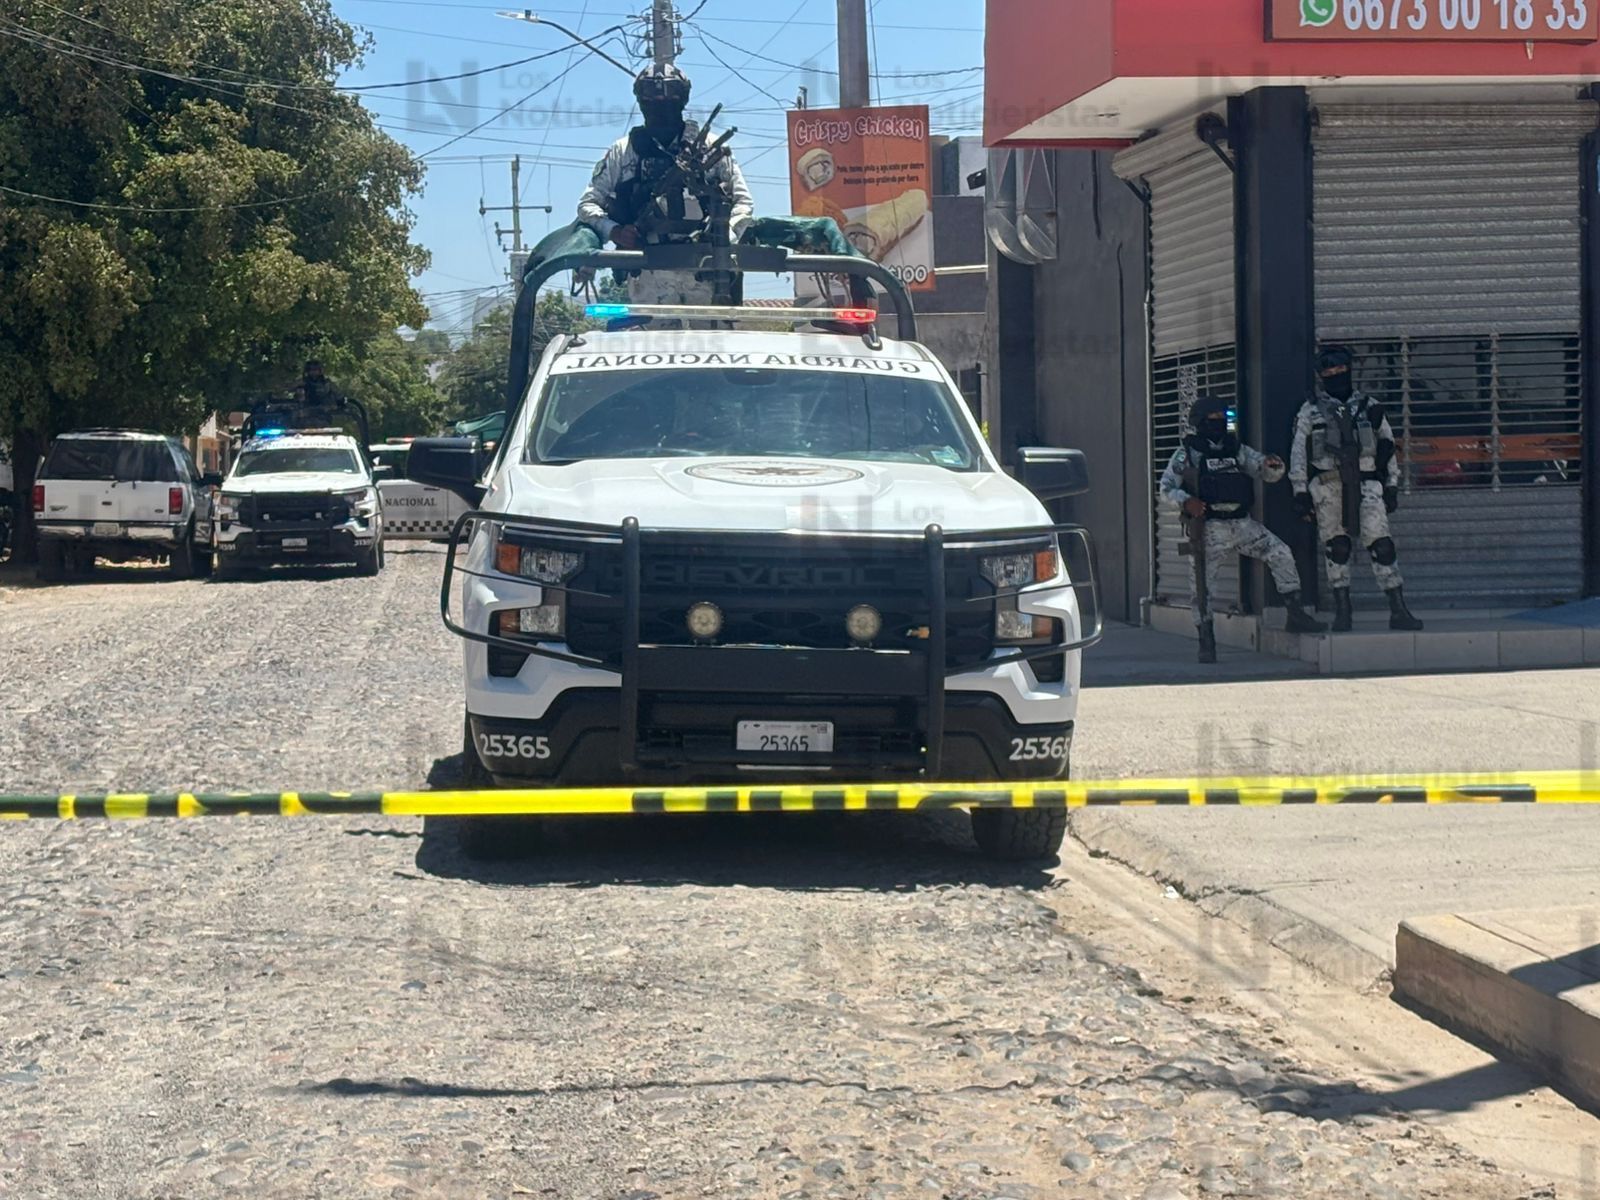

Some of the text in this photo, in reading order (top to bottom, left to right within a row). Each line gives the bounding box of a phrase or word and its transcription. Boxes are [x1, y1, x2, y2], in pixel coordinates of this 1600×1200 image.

[1343, 0, 1588, 30] 6673 00 18 33
[794, 115, 924, 145] Crispy Chicken
[384, 497, 438, 508] NACIONAL
[479, 732, 551, 760] 25365
[760, 734, 809, 752] 25365
